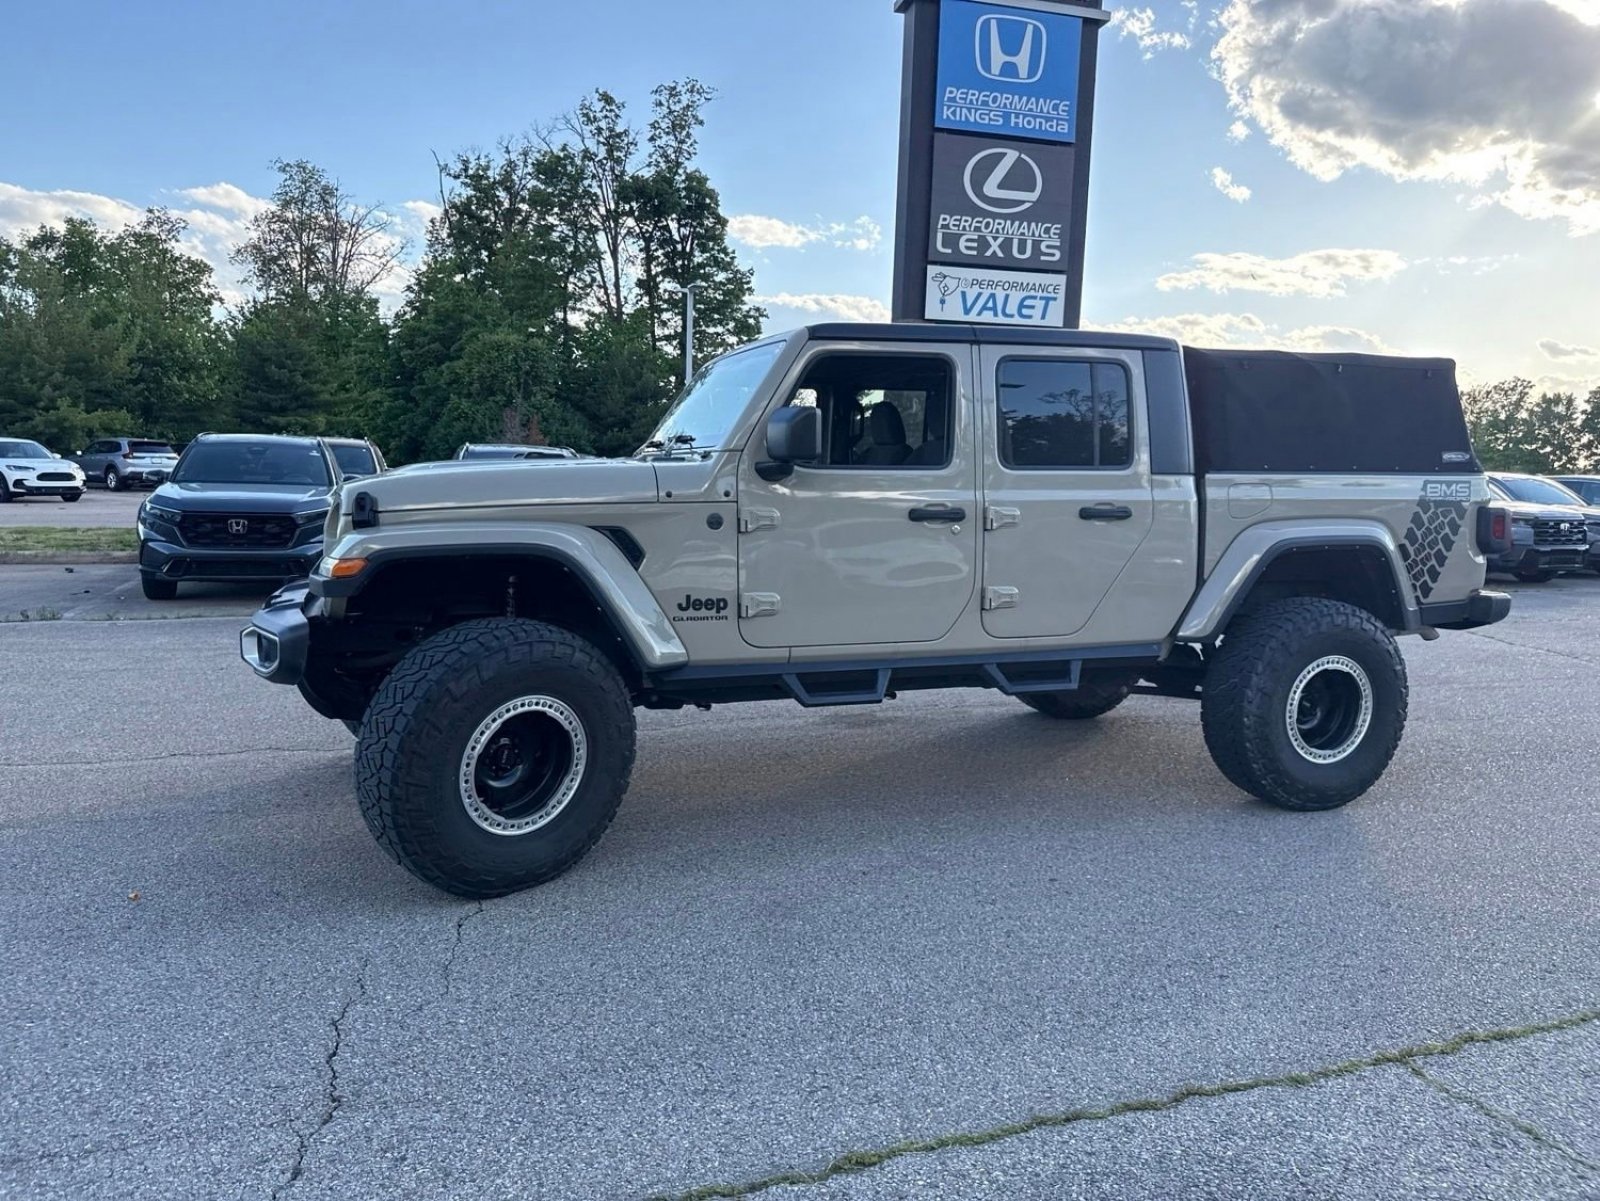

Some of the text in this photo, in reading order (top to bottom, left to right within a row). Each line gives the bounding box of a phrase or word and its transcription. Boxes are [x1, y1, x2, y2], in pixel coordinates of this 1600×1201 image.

[944, 87, 1070, 116] PERFORMANCE
[943, 106, 1068, 133] KINGS Honda
[937, 214, 1062, 238] PERFORMANCE
[936, 232, 1061, 262] LEXUS
[970, 278, 1061, 294] PERFORMANCE
[960, 290, 1058, 320] VALET
[1426, 483, 1470, 497] BMS
[677, 594, 728, 614] Jeep
